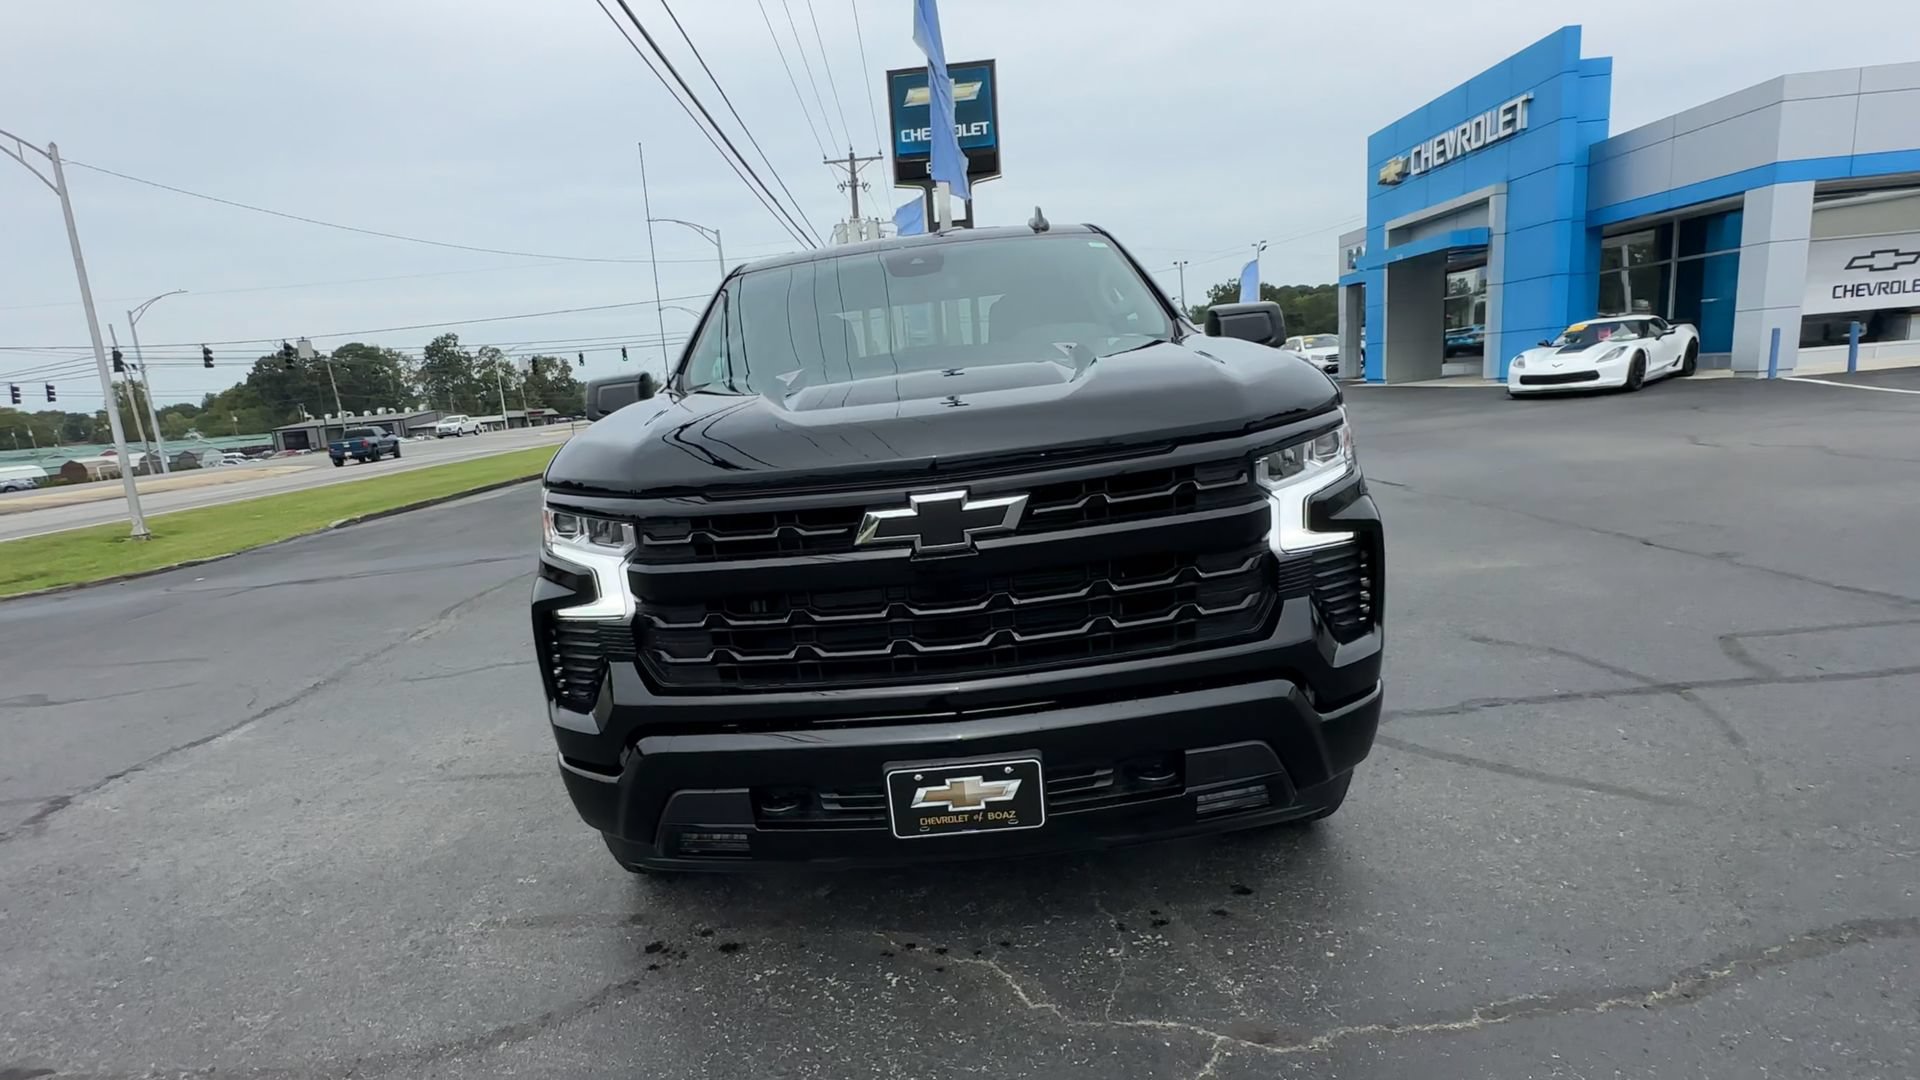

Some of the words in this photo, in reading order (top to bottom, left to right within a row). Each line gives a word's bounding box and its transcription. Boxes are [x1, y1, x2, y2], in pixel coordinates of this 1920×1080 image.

[901, 121, 990, 143] CHEOLET
[1410, 91, 1534, 176] CHEVROLET
[919, 813, 969, 826] CHEVROLET
[987, 810, 1017, 820] BOAZ
